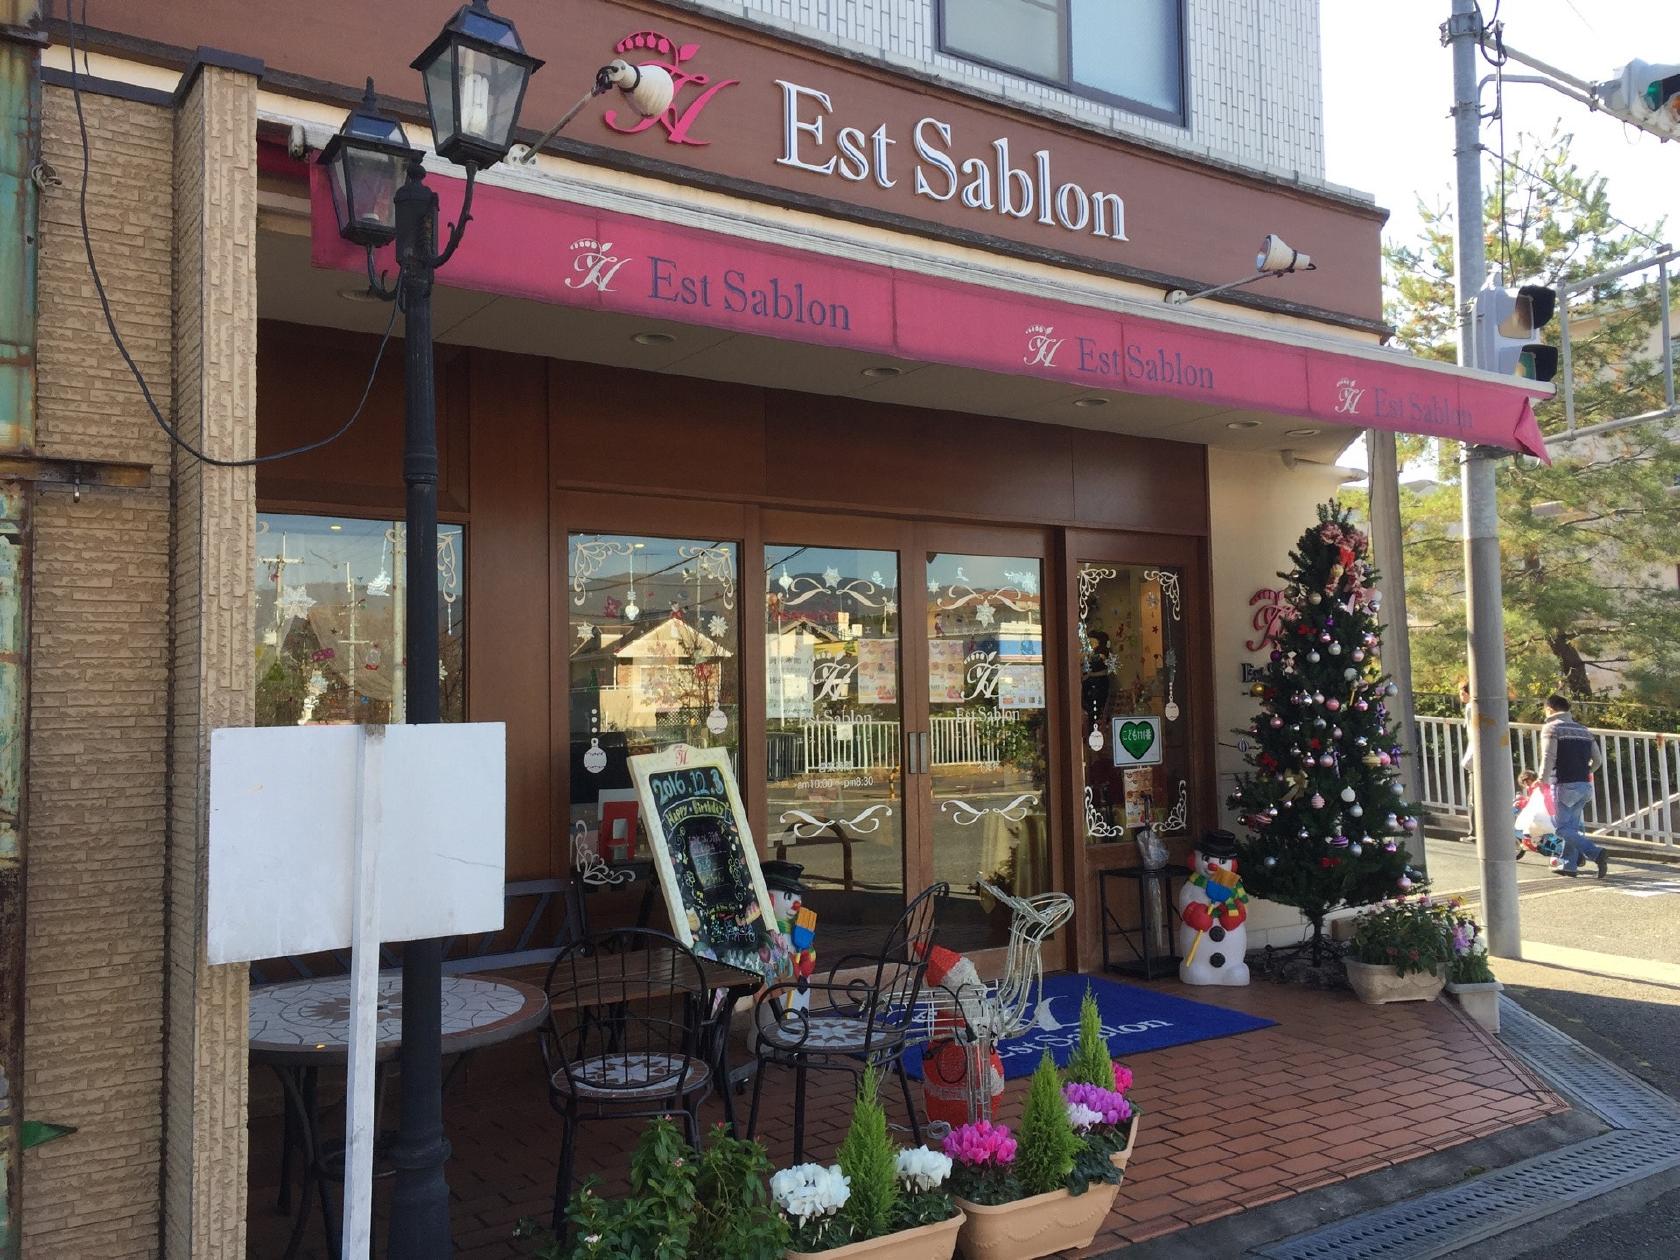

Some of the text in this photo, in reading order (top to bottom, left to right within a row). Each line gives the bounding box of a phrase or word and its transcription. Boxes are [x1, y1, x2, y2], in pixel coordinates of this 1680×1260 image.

[775, 80, 897, 189] Est
[913, 117, 1129, 242] Sablon
[647, 256, 710, 307] Est
[724, 270, 851, 331] Sablon
[1077, 337, 1120, 375] Est
[1127, 345, 1215, 390] Sablon
[1374, 388, 1404, 419] Est
[1408, 392, 1473, 429] Sablon
[800, 709, 872, 727] Est Sablon
[955, 706, 1020, 723] Est Sablon
